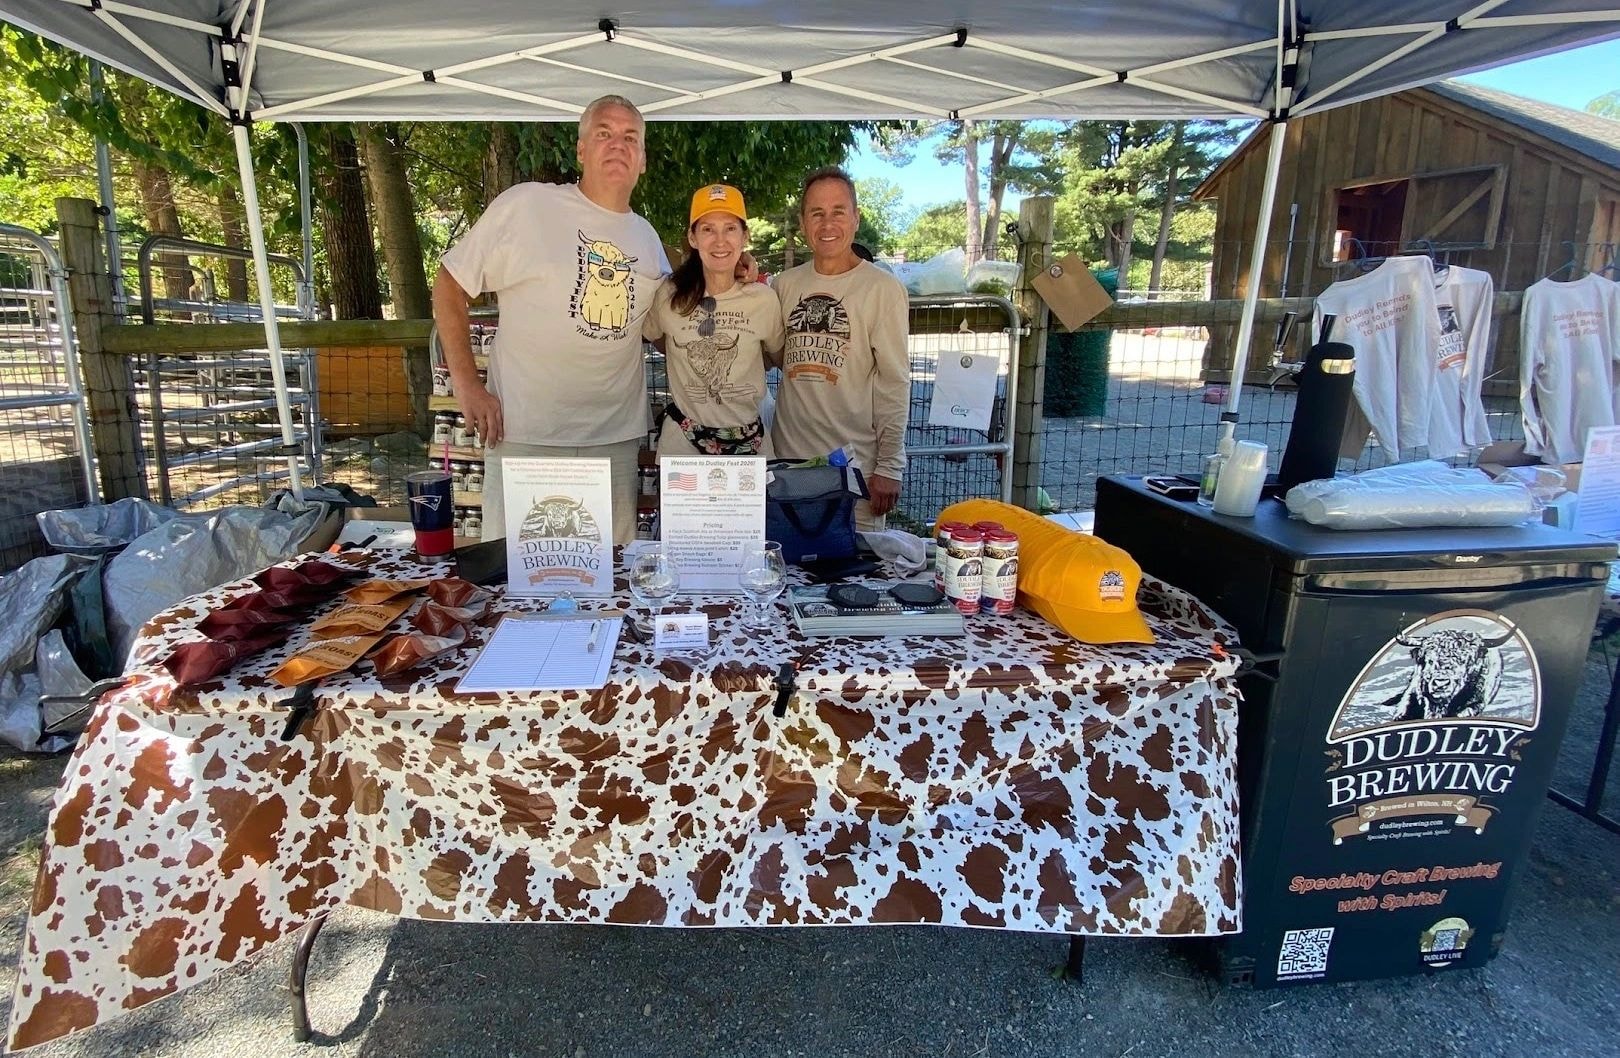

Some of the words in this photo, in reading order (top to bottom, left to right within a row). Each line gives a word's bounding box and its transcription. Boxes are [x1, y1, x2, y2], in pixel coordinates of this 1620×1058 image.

[568, 246, 585, 318] DUDLEYFEST
[576, 325, 597, 340] Make
[788, 336, 846, 352] DUDLEY
[787, 350, 844, 368] BREWING
[524, 540, 598, 554] DUDLEY
[522, 554, 600, 570] BREWING
[1342, 726, 1524, 769] DUDLEY
[1327, 762, 1515, 808] BREWING
[1380, 802, 1407, 812] Brewed
[1379, 820, 1443, 830] dudleybrewing.com
[1289, 871, 1381, 896] Specialty
[1381, 865, 1429, 886] Craft
[1428, 861, 1503, 883] Brewing
[1338, 894, 1379, 913] with
[1380, 889, 1448, 911] Spirits!
[1423, 954, 1447, 962] DUDLEY
